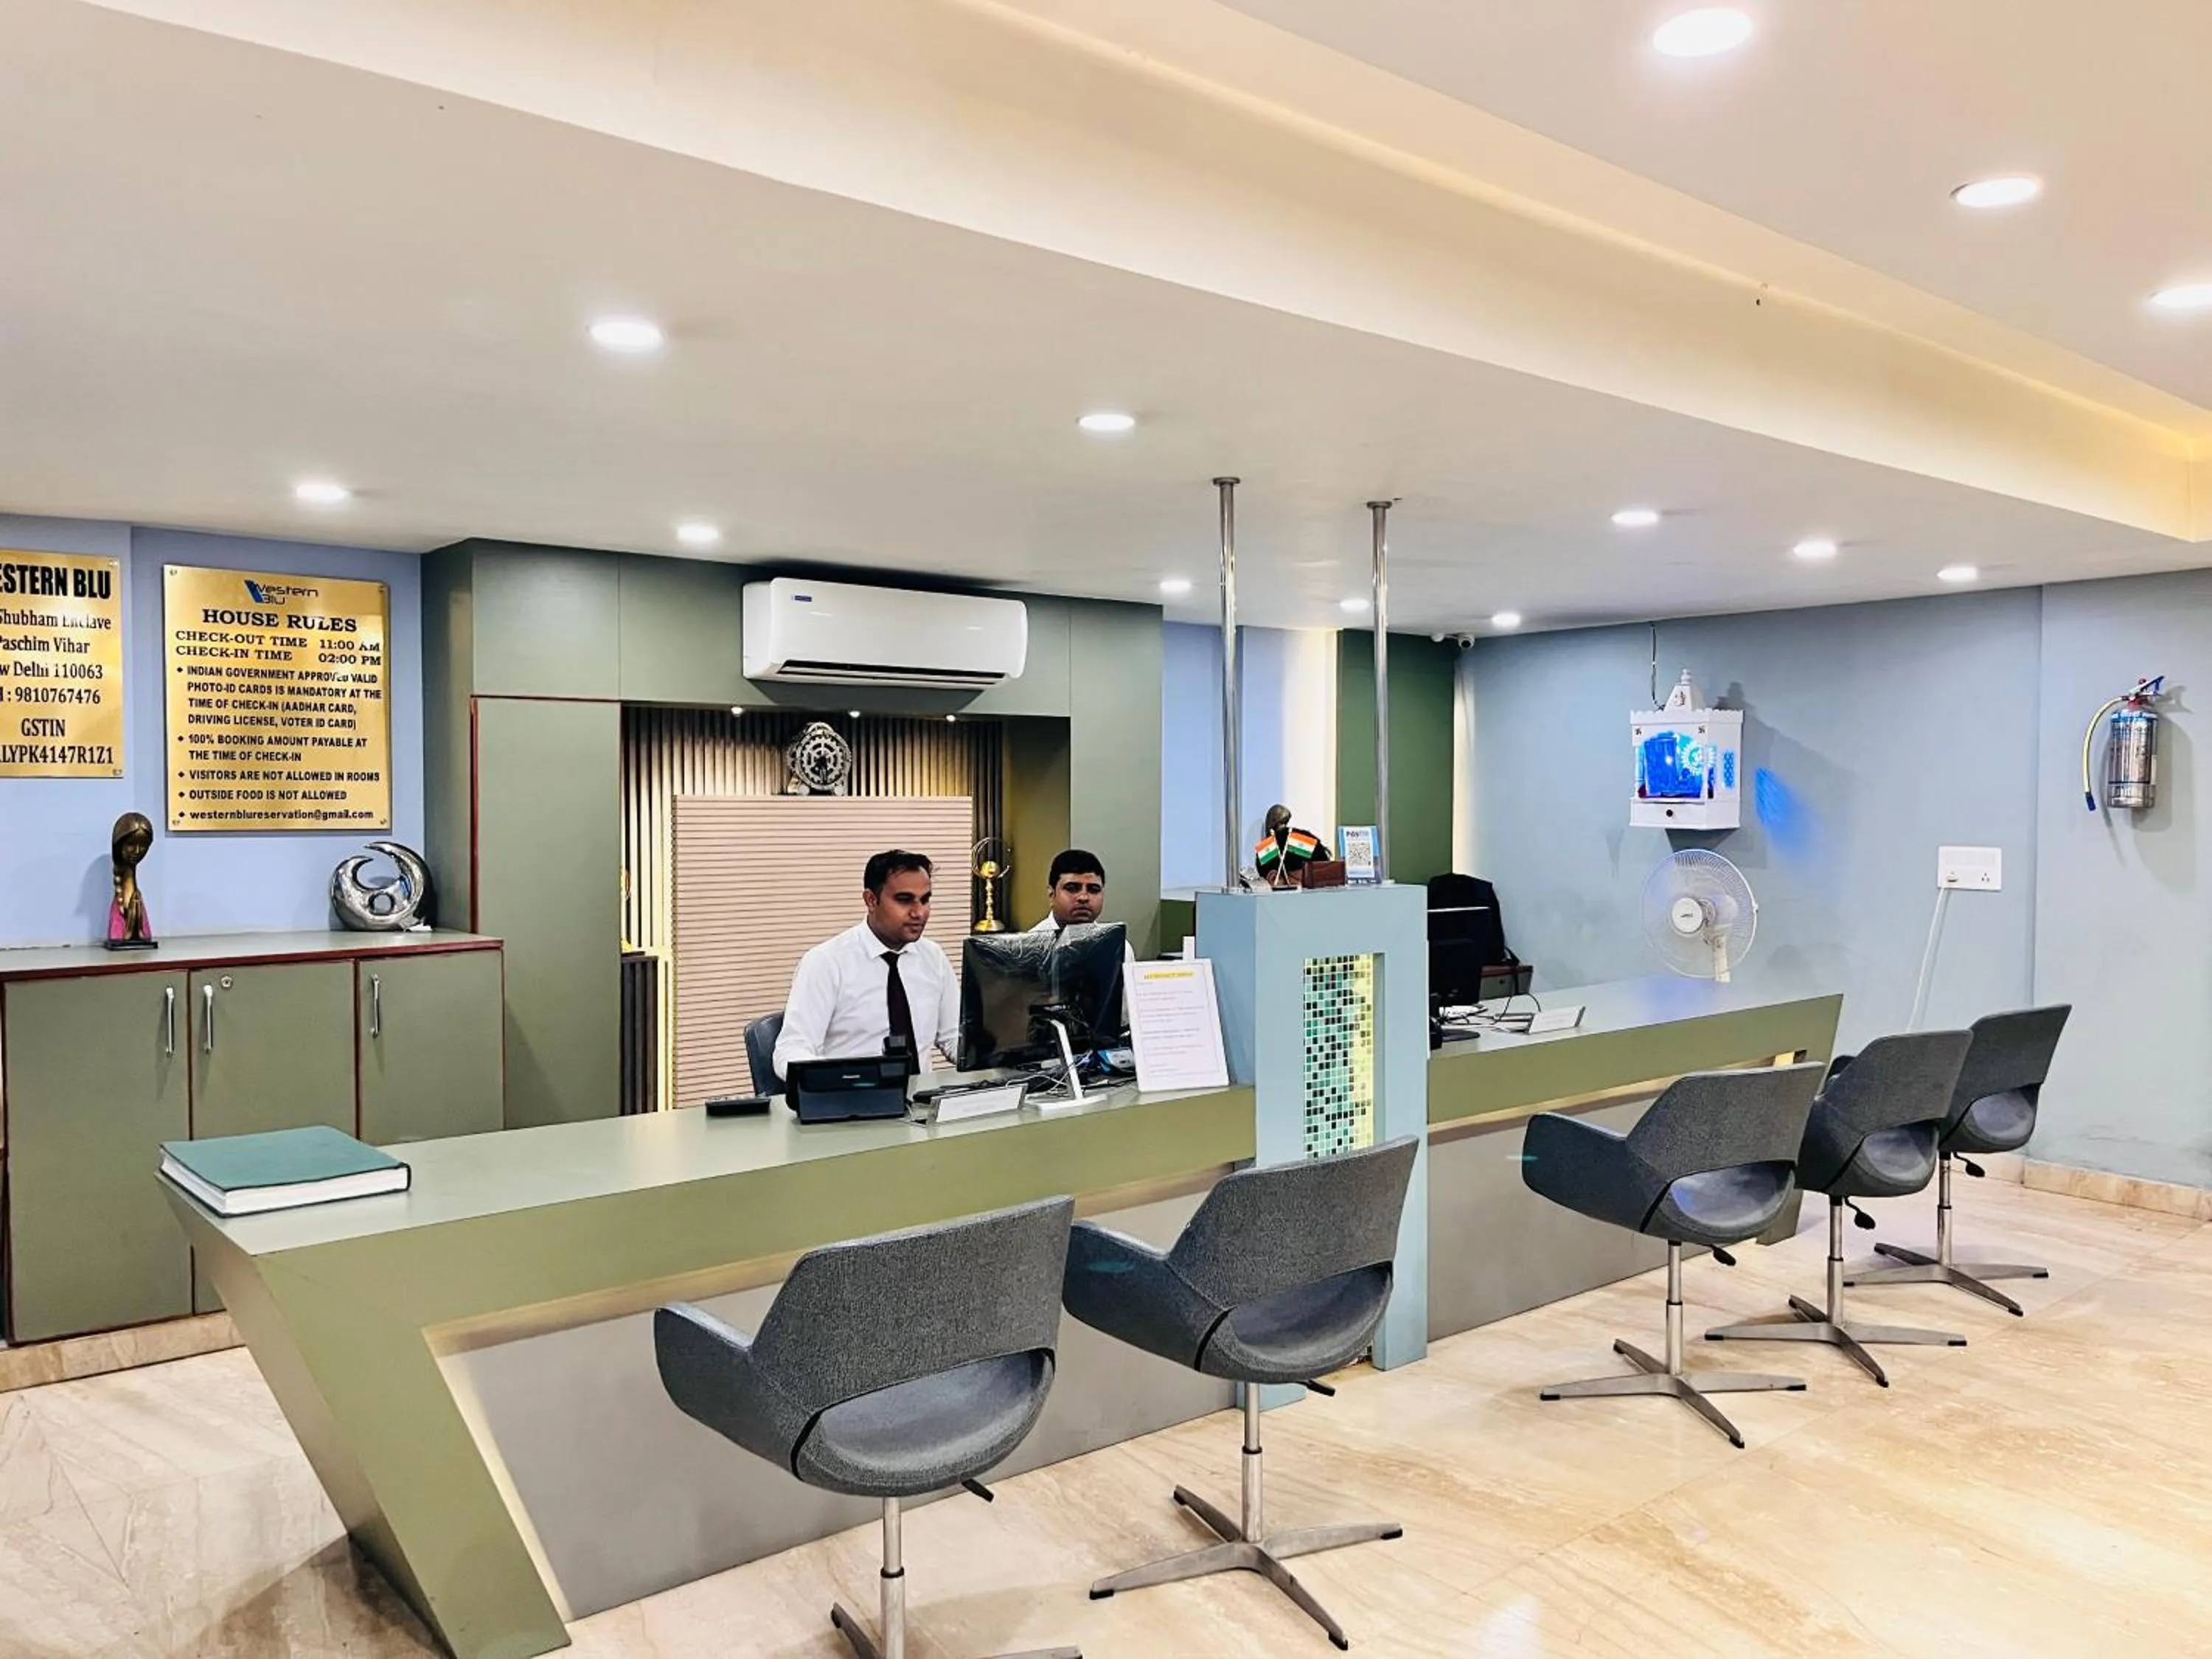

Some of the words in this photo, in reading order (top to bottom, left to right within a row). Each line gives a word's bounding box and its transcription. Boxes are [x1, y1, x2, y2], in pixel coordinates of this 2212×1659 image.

[0, 563, 67, 596] STERN
[73, 568, 111, 599] BLU
[202, 609, 279, 627] HOUSE
[287, 614, 358, 632] RULES
[0, 634, 49, 652] aschim
[53, 637, 90, 653] Vihar
[175, 630, 265, 645] CHECK-OUT
[270, 636, 307, 648] TIME
[319, 639, 355, 650] 11:00
[359, 641, 380, 652] AM
[175, 645, 249, 658] CHECK-IN
[254, 650, 293, 661] TIME
[319, 653, 357, 664] 02:00
[361, 655, 381, 666] PM
[13, 661, 49, 677] Delhi
[54, 663, 102, 679] 110063
[187, 666, 222, 676] INDIAN
[226, 667, 295, 679] GOVERNMENT
[351, 673, 378, 684] VALID
[15, 686, 101, 704] 9810767476
[187, 682, 236, 693] PHOTO-ID
[238, 684, 272, 694] CARDS
[275, 685, 285, 695] IS
[288, 686, 347, 698] MANDATORY
[349, 689, 361, 698] AT
[364, 689, 382, 699] THE
[188, 698, 213, 708] TIME
[215, 699, 229, 709] OF
[232, 700, 279, 710] CHECK-IN
[281, 701, 325, 713] (AADHAR
[328, 703, 356, 714] CARD,
[21, 718, 66, 737] GSTIN
[188, 714, 231, 725] DRIVING
[233, 715, 278, 728] LICENSE,
[281, 717, 313, 727] VOTER
[316, 718, 325, 728] ID
[328, 718, 356, 730] CARD)
[189, 734, 214, 744] 100%
[218, 734, 264, 745] BOOKING
[267, 736, 309, 746] AMOUNT
[312, 737, 353, 747] PAYABLE
[355, 738, 367, 748] AT
[0, 745, 114, 764] LYPK4147R1Z1
[189, 750, 209, 760] THE
[212, 751, 236, 760] TIME
[239, 751, 252, 760] OF
[255, 751, 302, 762] CHECK-IN
[189, 770, 236, 779] VISITORS
[240, 771, 260, 780] ARE
[263, 771, 284, 780] NOT
[285, 771, 332, 781] ALLOWED
[334, 772, 344, 781] IN
[347, 772, 380, 782] ROOMS
[189, 790, 234, 799] OUTSIDE
[237, 790, 263, 799] FOOD
[266, 790, 275, 800] IS
[278, 790, 299, 799] NOT
[301, 790, 347, 800] ALLOWED
[189, 810, 374, 820] westernblureservation@gmail.com
